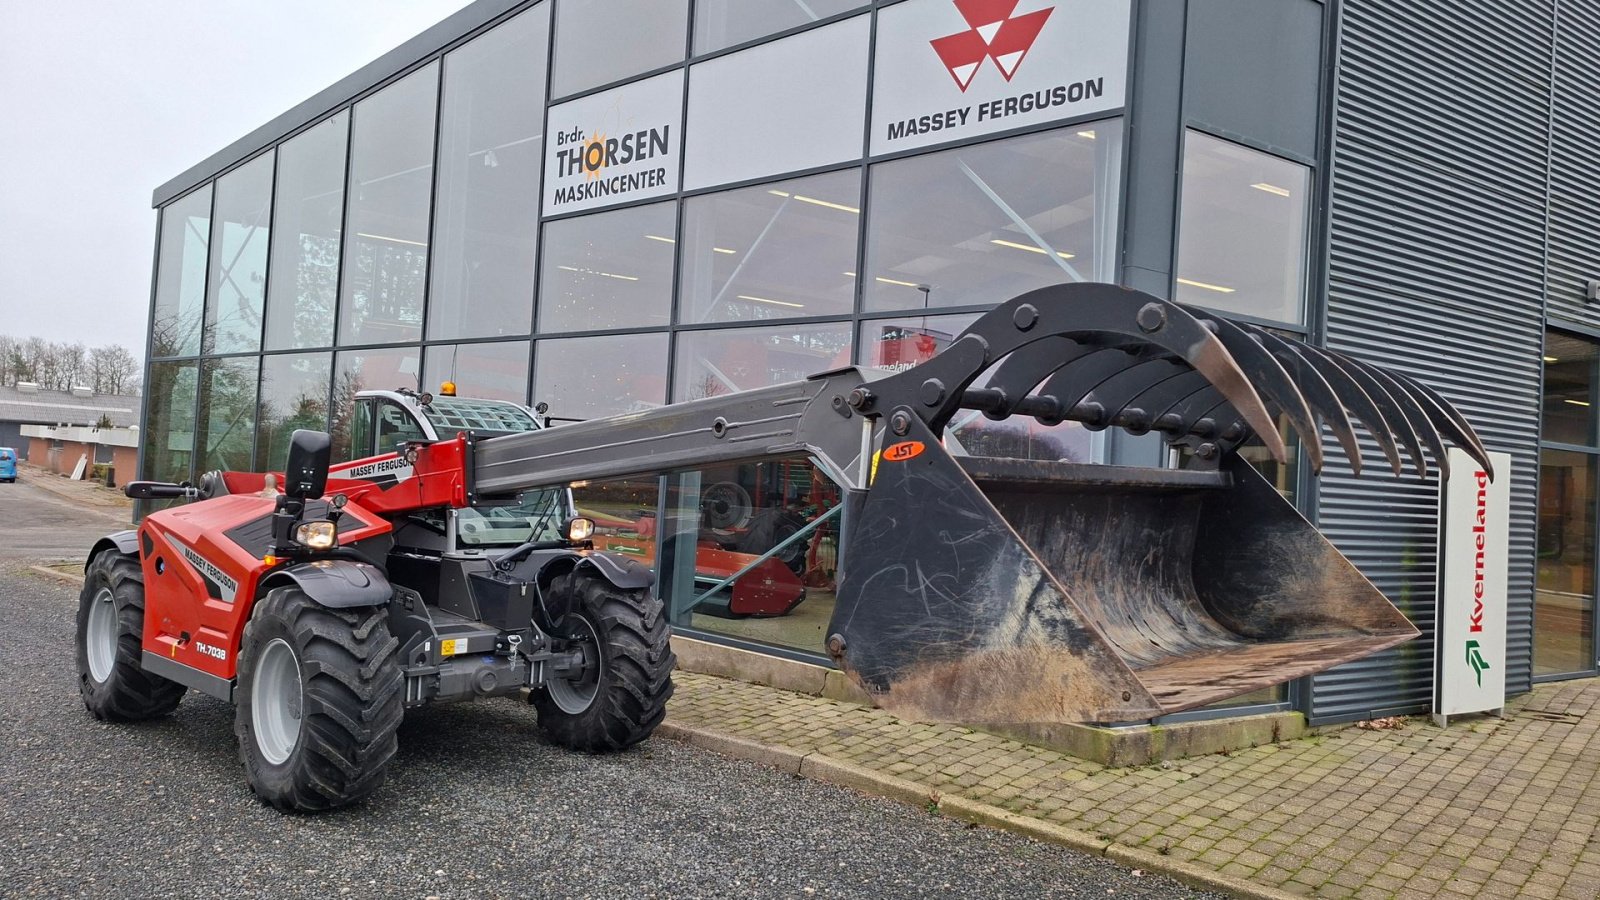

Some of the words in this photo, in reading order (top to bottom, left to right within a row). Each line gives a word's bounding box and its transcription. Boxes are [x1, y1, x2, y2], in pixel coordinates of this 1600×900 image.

[887, 106, 971, 141] MASSEY
[977, 77, 1104, 122] FERGUSON
[556, 125, 670, 178] THORSEN
[557, 126, 585, 146] Brdr.
[553, 167, 666, 205] MASKINCENTER
[350, 464, 377, 478] MASSEY
[184, 547, 206, 570] MASSEY
[206, 563, 237, 593] FERGUSON
[1470, 470, 1487, 633] Kverneland
[196, 641, 226, 660] TH.7038
